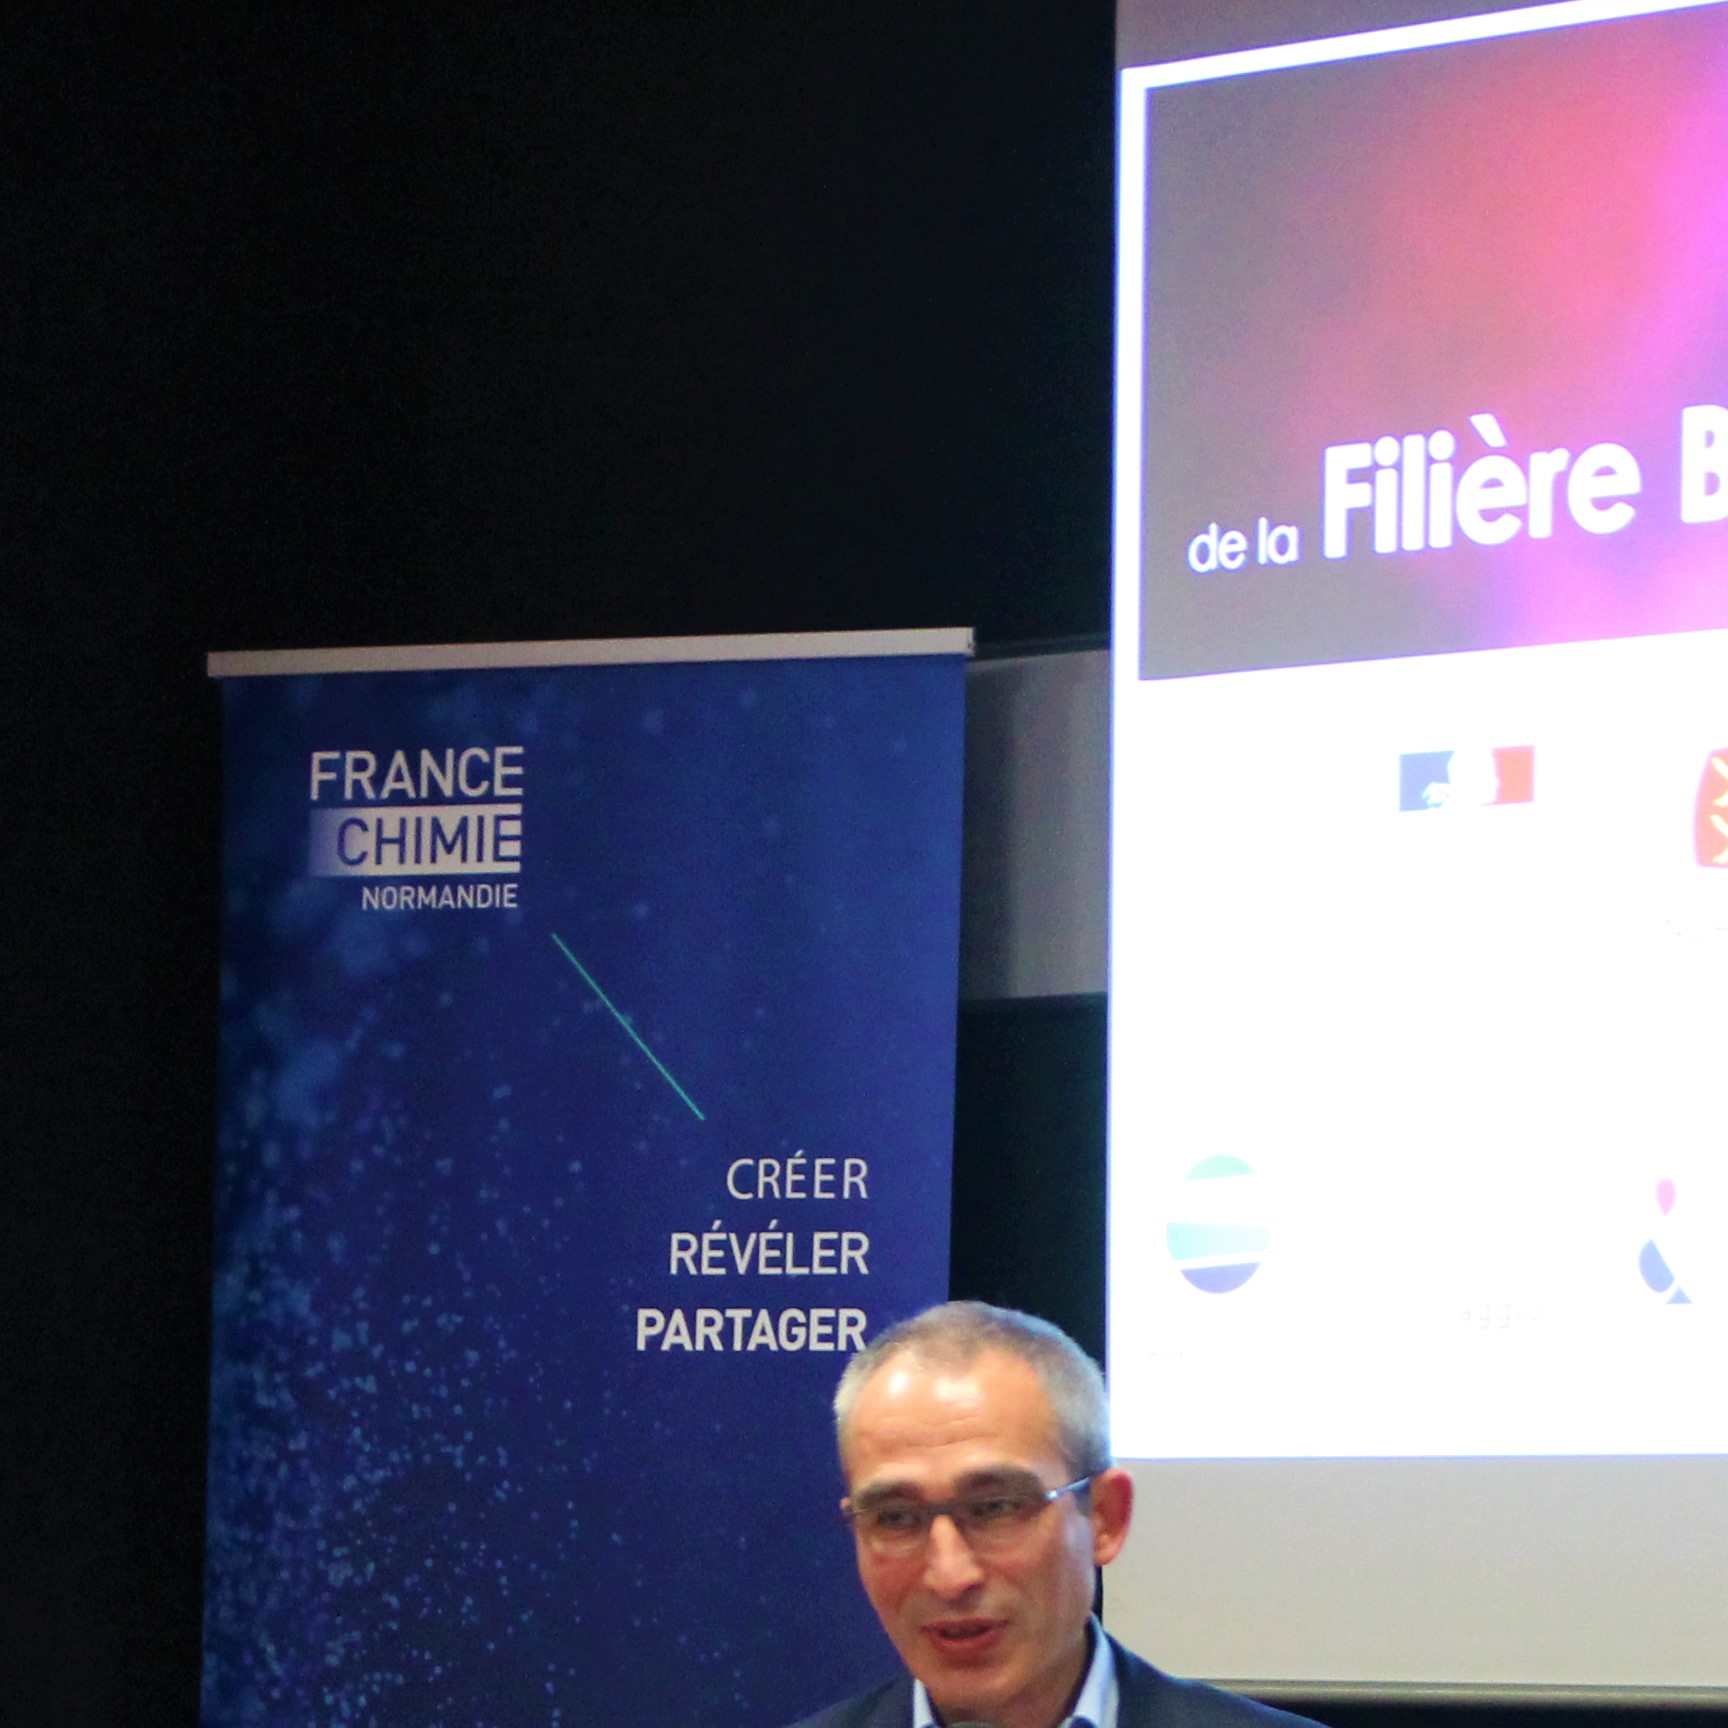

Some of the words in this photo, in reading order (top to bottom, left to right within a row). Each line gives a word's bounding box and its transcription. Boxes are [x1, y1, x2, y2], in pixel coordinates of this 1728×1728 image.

[1188, 521, 1249, 574] de
[1257, 516, 1301, 566] la
[1323, 412, 1642, 560] Filière
[309, 746, 524, 801] FRANCE
[336, 813, 521, 866] CHIMIE
[361, 883, 519, 911] NORMANDIE
[726, 1149, 869, 1200] CRÉER
[669, 1218, 870, 1276] RÉVÉLER
[636, 1308, 869, 1352] PARTAGER
